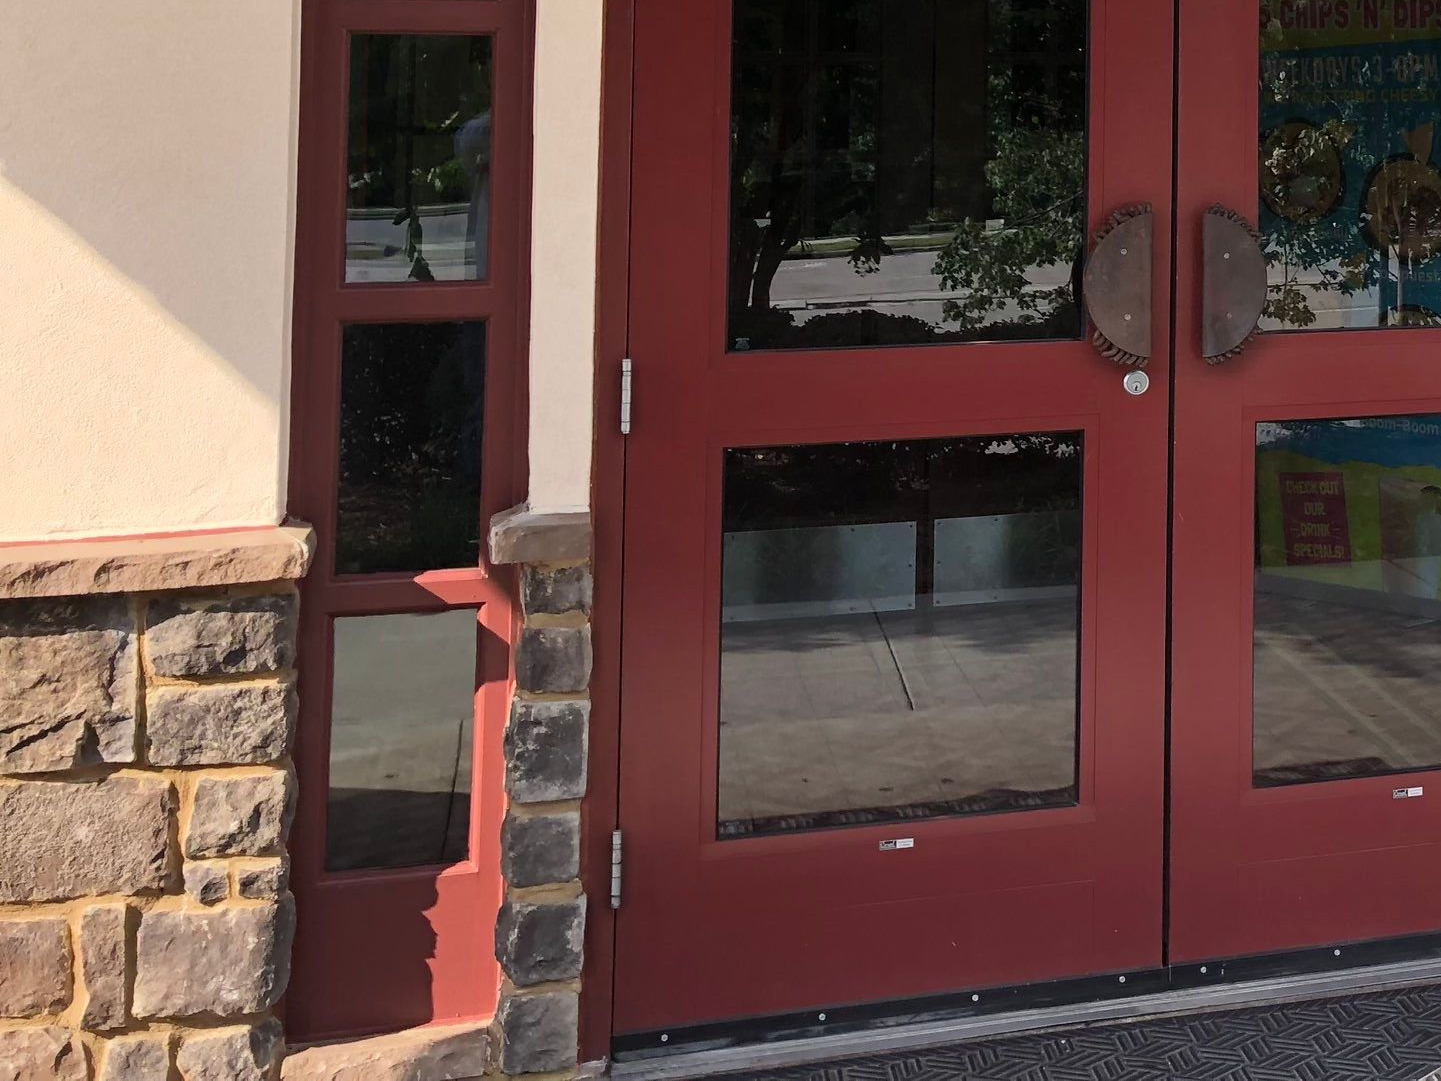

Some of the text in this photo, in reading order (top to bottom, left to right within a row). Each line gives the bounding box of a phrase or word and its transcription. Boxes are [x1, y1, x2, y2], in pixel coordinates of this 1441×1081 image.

[1286, 480, 1341, 495] CHECK OUT
[1303, 501, 1325, 516] OUR
[1300, 522, 1331, 537] DRINK
